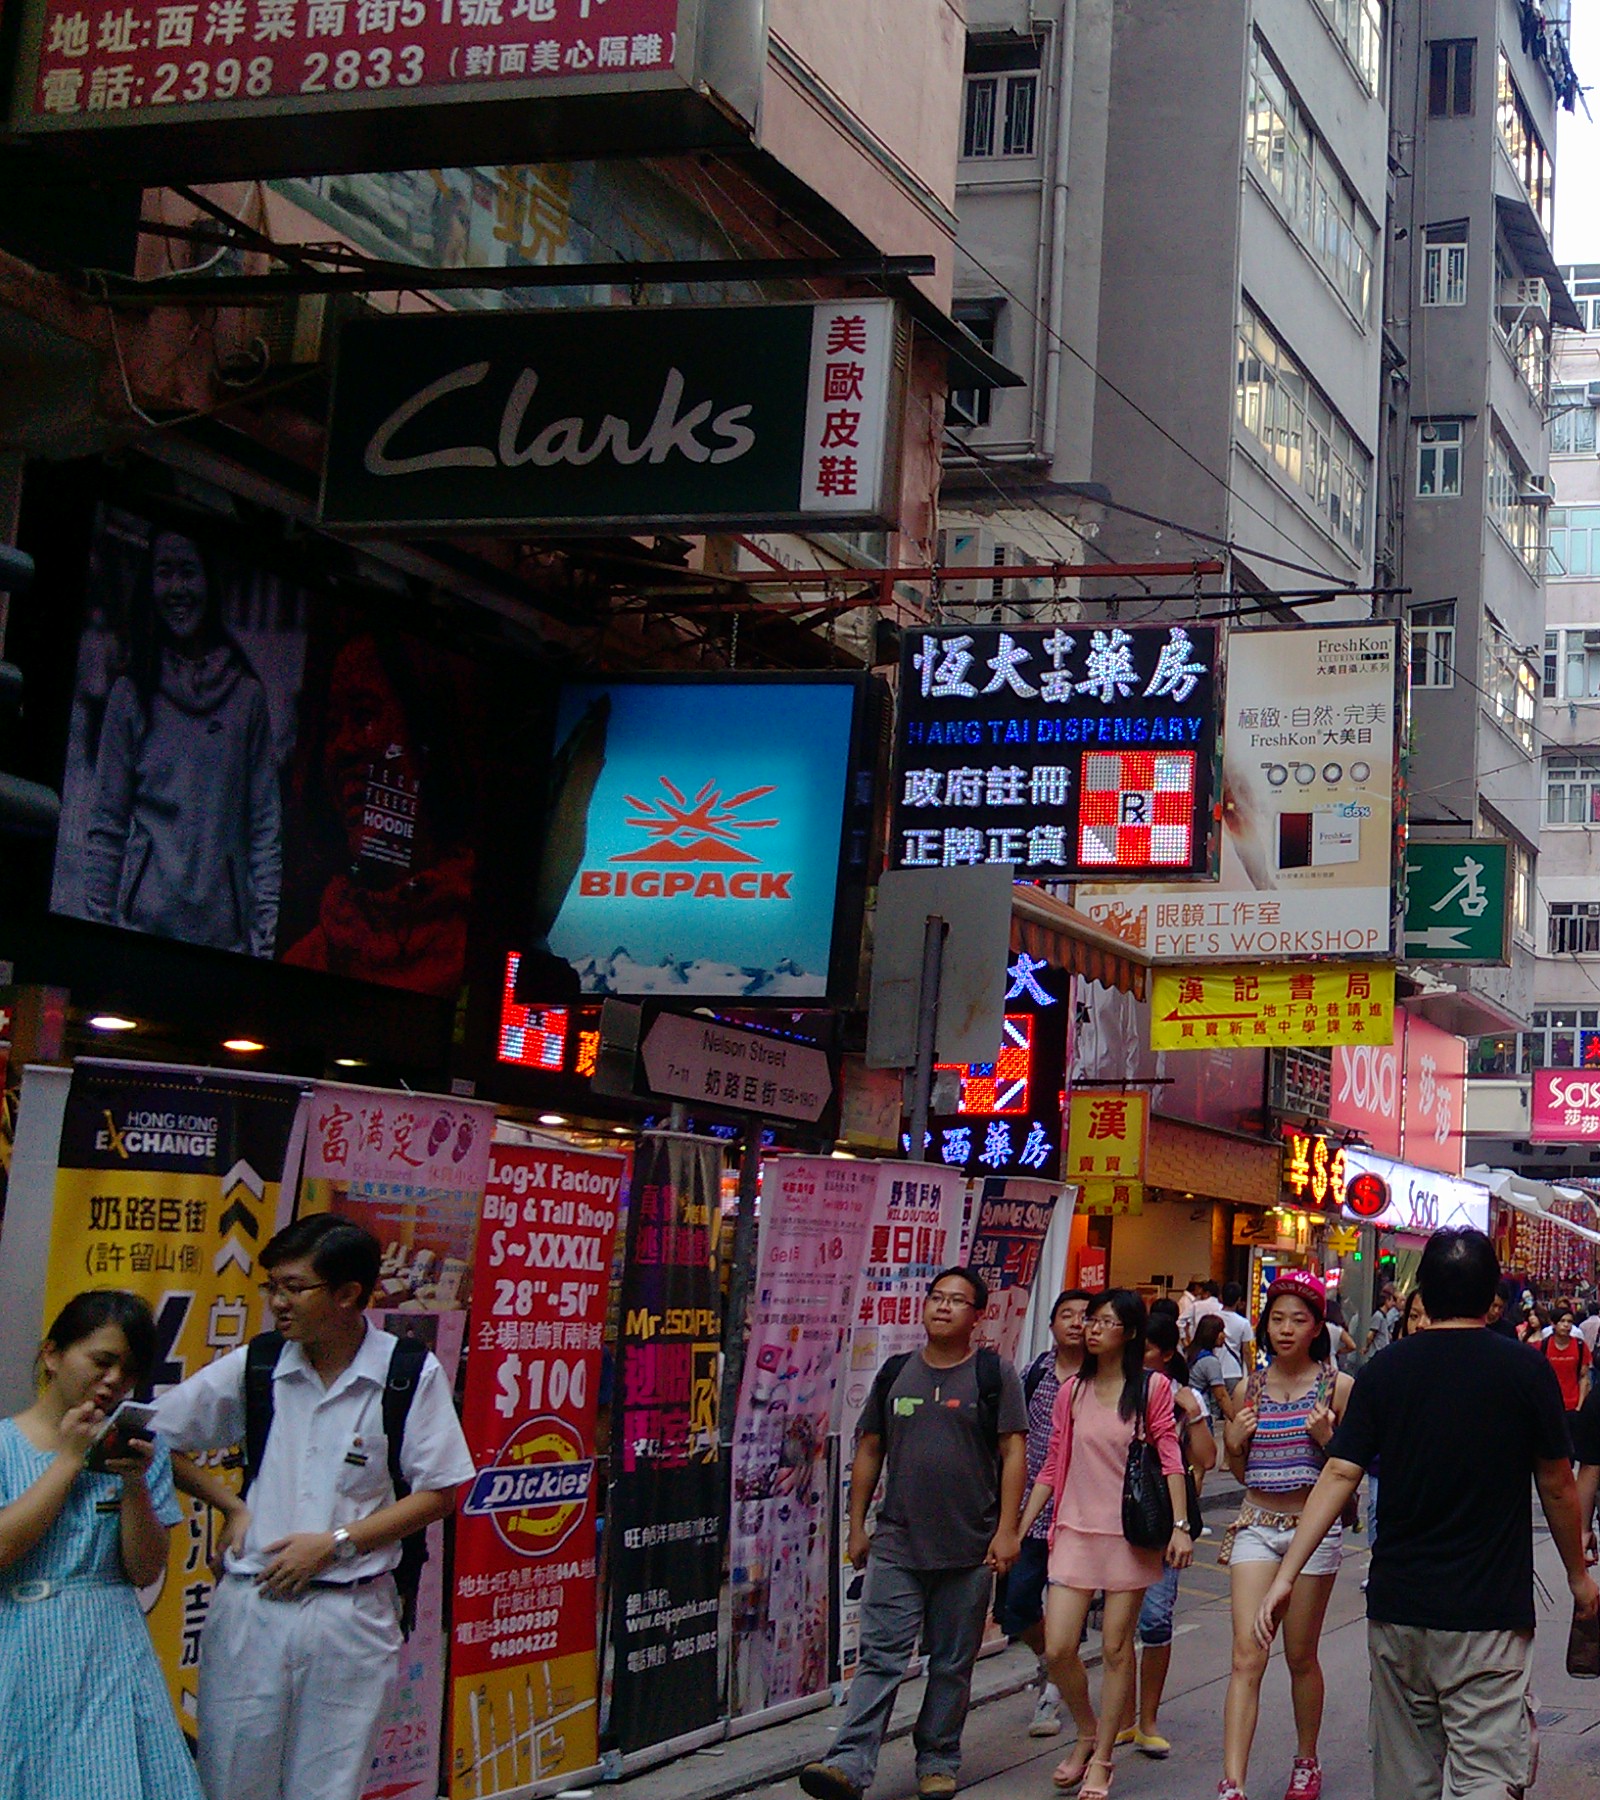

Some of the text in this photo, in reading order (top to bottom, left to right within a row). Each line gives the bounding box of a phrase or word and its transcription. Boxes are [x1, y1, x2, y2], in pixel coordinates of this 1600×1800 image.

[300, 44, 425, 92] 2833
[364, 361, 756, 477] Clarks
[815, 314, 867, 497] 美歐皮鞋
[1317, 636, 1389, 653] FreshKon
[908, 715, 1202, 745] HANG TAI DISPENSARY
[902, 765, 1071, 808] 政府註冊
[363, 809, 416, 840] HOODIE
[579, 870, 794, 901] BIGPACK
[1155, 901, 1282, 928] 眼鏡工作室
[1155, 928, 1379, 955] EYE'S WORKSHOP
[1178, 972, 1371, 1004] 漢記書局
[701, 1029, 788, 1067] Nelson Street
[703, 1067, 778, 1107] 奶路臣街
[95, 1109, 217, 1160] EXCHANGE
[128, 1110, 219, 1133] HONG KONG
[1088, 1100, 1128, 1141] 漢
[1564, 1108, 1600, 1134] 莎莎
[487, 1158, 546, 1195] Log-X
[551, 1163, 620, 1203] Factory
[88, 1195, 208, 1234] 奶路臣街
[483, 1195, 517, 1228] Big
[522, 1197, 537, 1222] &
[541, 1198, 574, 1226] Tall
[577, 1201, 615, 1235] Shop
[1080, 1264, 1105, 1288] SALE
[487, 1466, 589, 1502] Dickies
